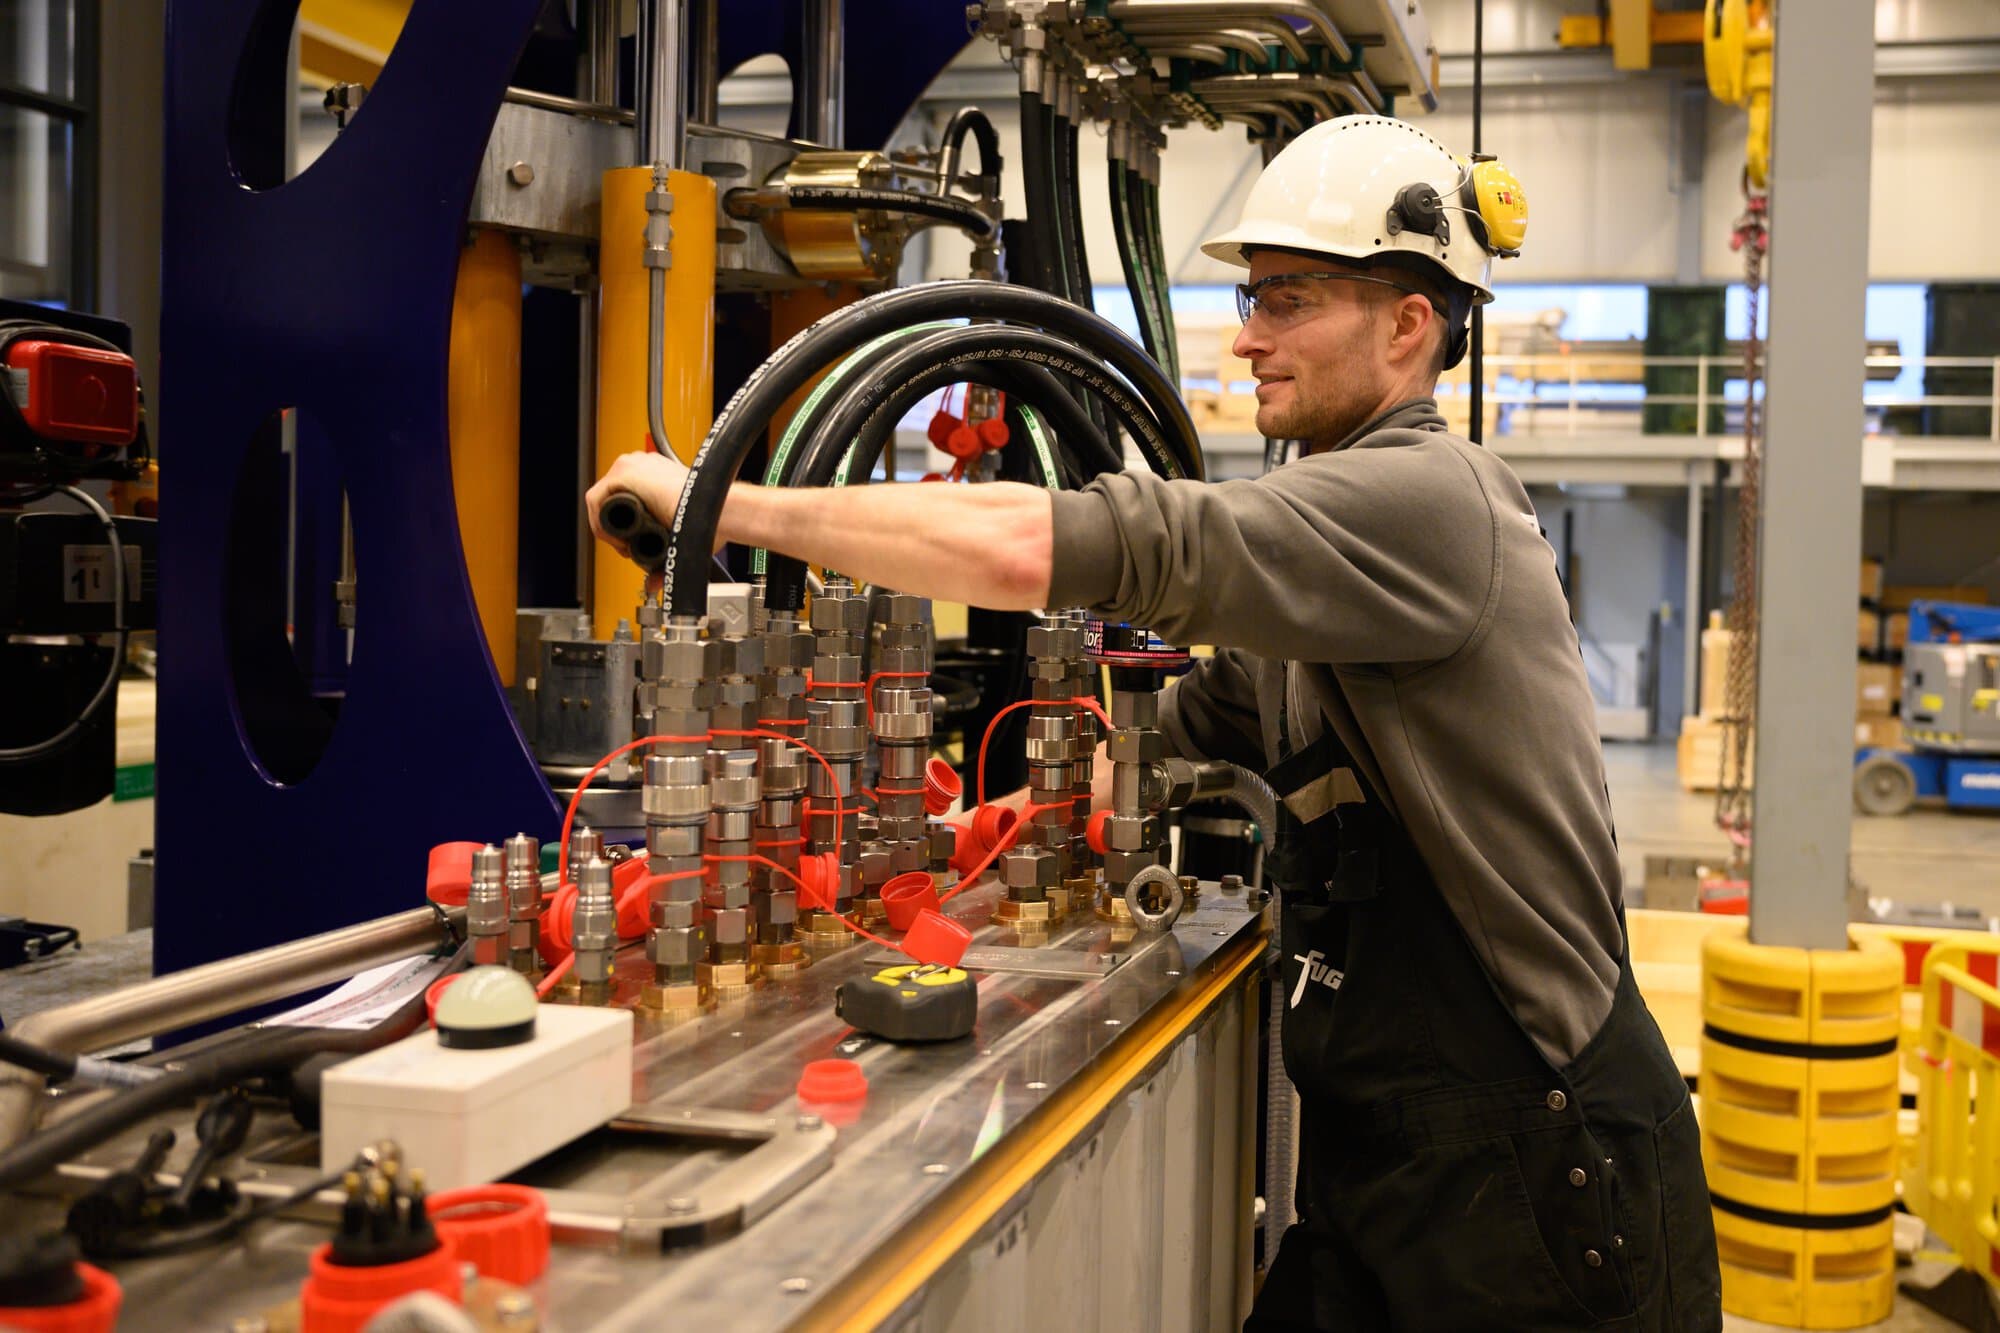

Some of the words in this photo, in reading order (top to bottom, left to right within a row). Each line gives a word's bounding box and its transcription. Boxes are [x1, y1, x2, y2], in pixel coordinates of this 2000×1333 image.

[987, 348, 1005, 358] ISO
[673, 470, 699, 533] exceeds
[694, 437, 715, 467] SAE
[710, 411, 729, 434] 100
